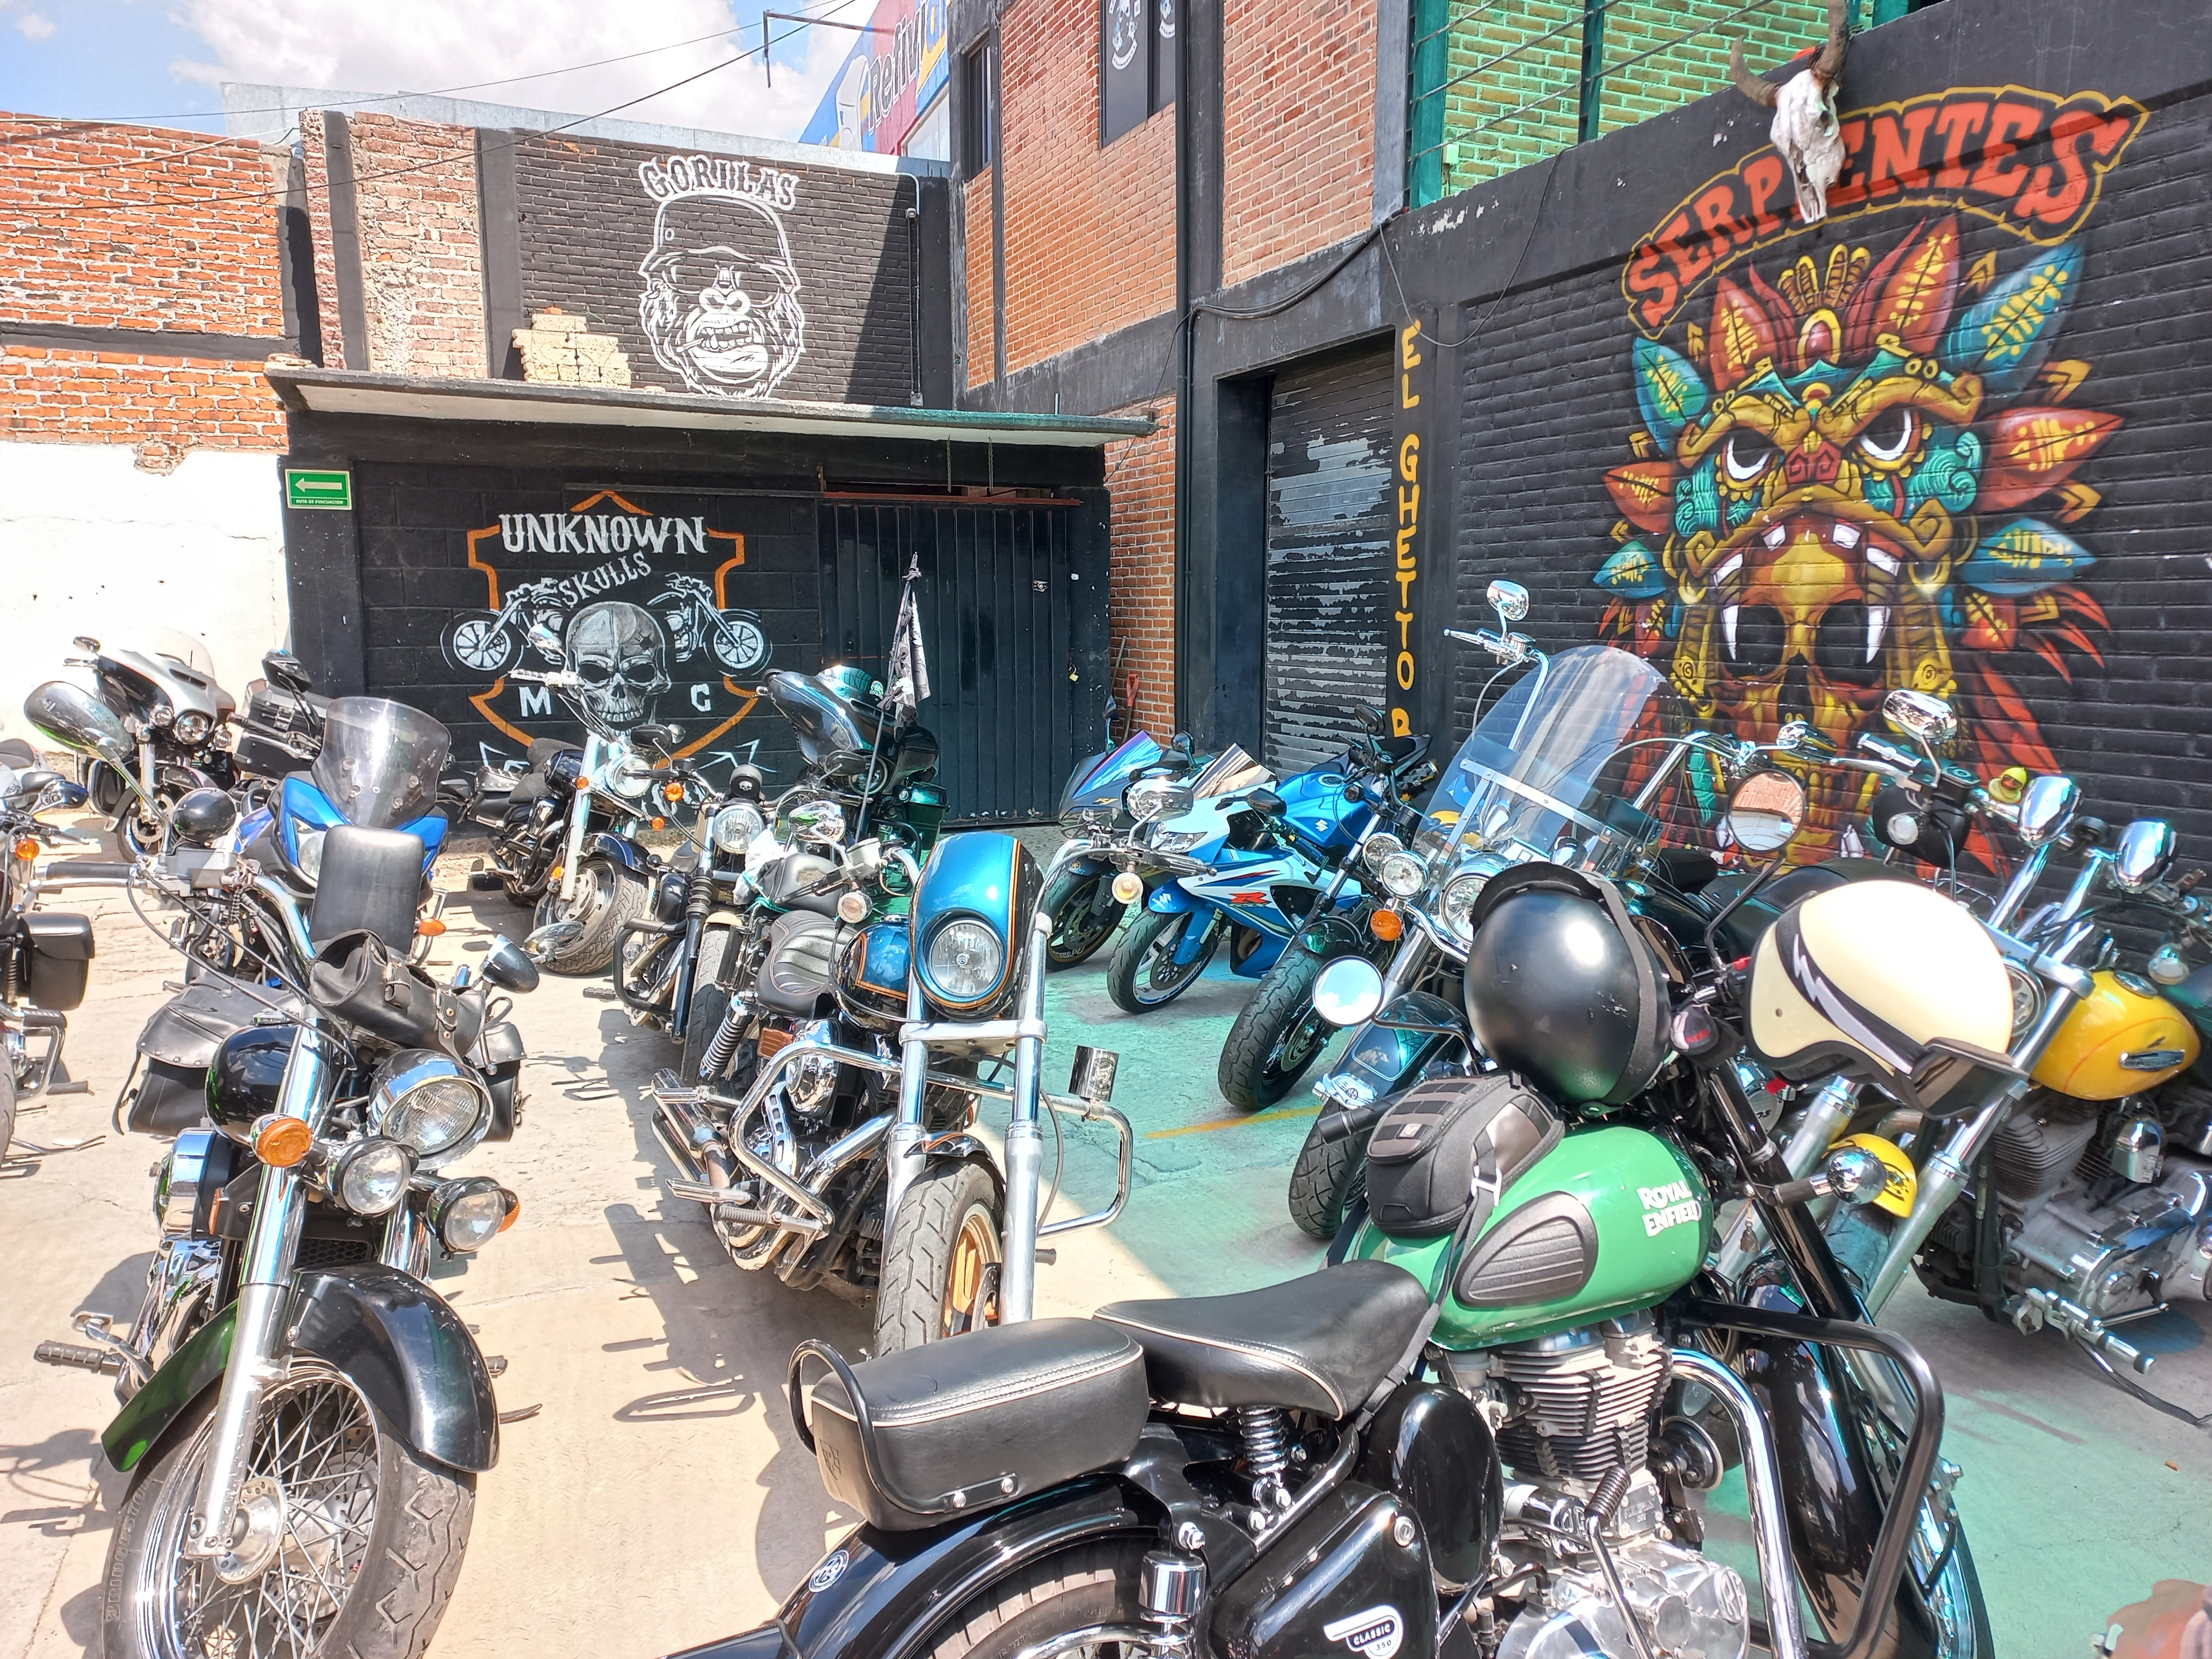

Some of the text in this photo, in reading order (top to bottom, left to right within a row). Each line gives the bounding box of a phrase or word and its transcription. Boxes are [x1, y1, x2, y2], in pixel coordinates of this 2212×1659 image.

[1627, 98, 2132, 328] SERPENTES
[498, 512, 709, 554] UNKNOWN
[559, 550, 653, 608] SKULLS
[1394, 432, 1421, 690] GHETTO
[519, 683, 713, 718] M C
[1636, 1180, 1692, 1210] ROYAL
[1641, 1200, 1702, 1237] ENFIELD
[1353, 1623, 1391, 1646] CLASSIC
[1376, 1639, 1392, 1651] 350
